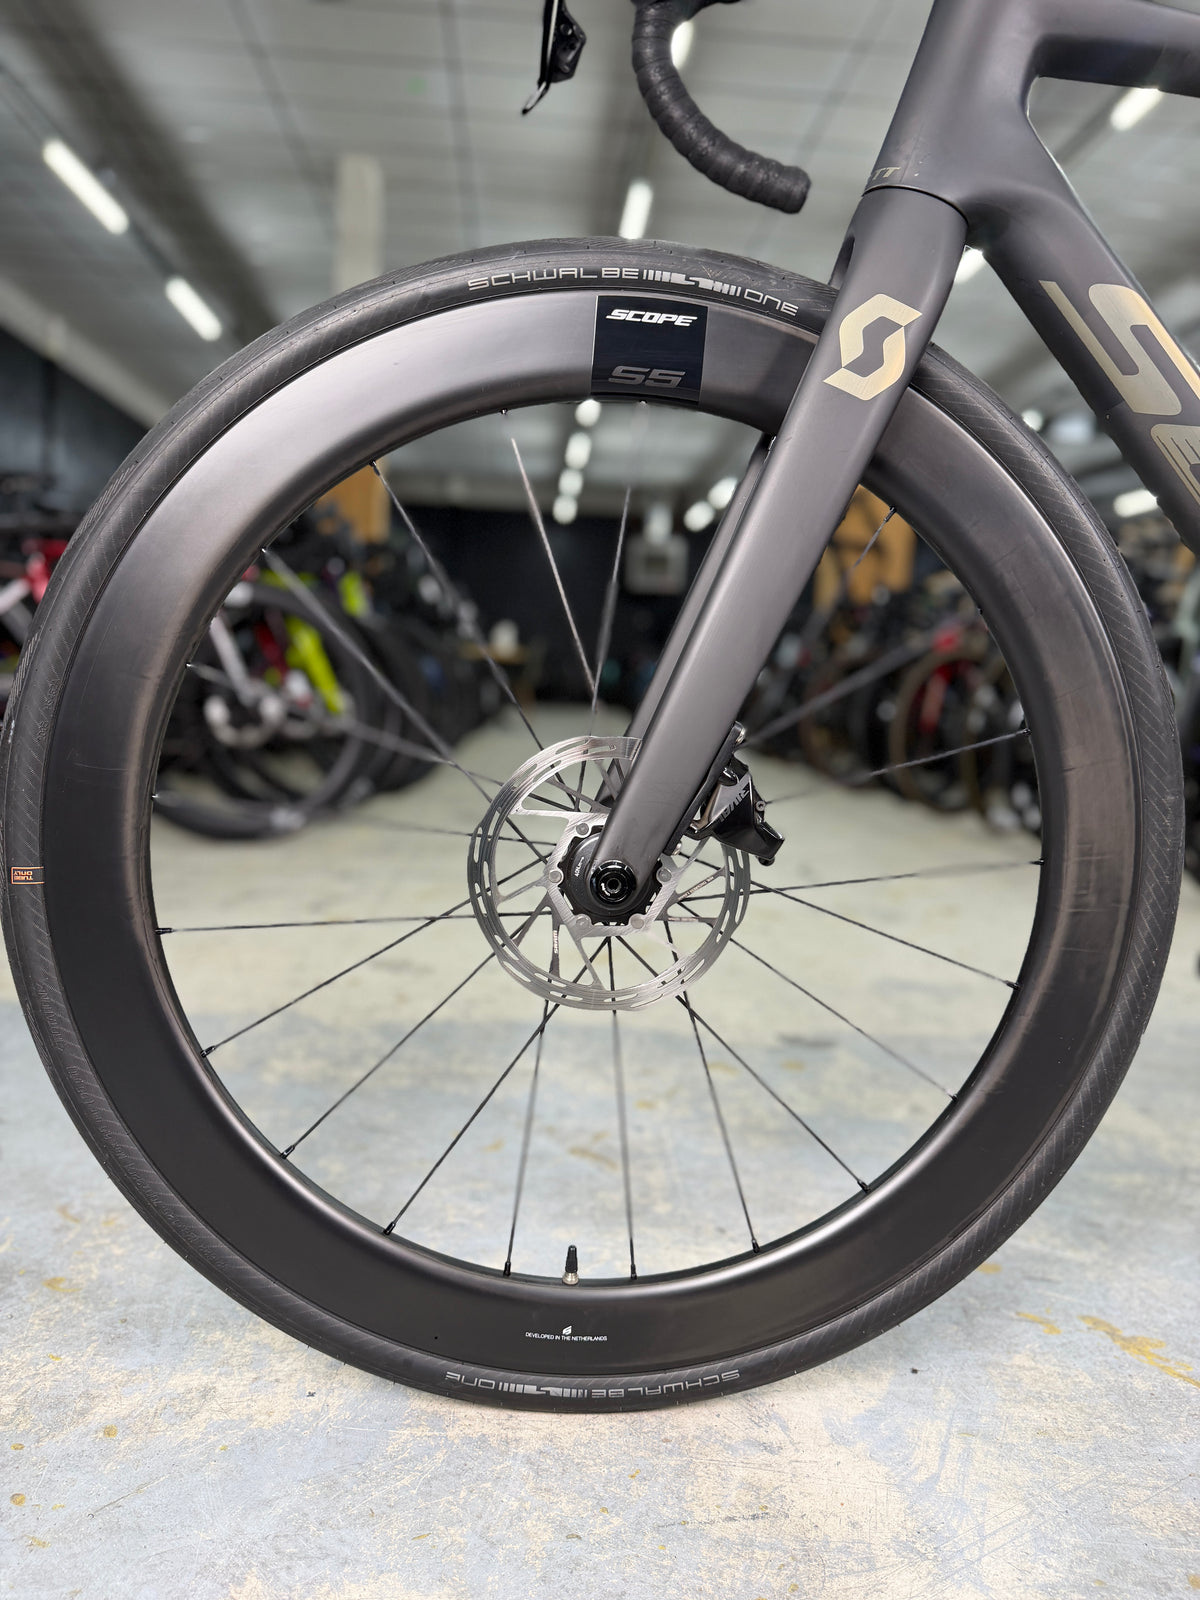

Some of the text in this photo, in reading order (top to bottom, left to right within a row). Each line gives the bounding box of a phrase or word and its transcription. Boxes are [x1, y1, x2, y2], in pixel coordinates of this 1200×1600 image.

[468, 267, 799, 316] SCHWALBE ONE
[605, 308, 698, 327] SCOPE
[608, 365, 686, 389] S5
[525, 1331, 555, 1340] DEVELOPED
[445, 1368, 741, 1399] SCHWALBE ONE
